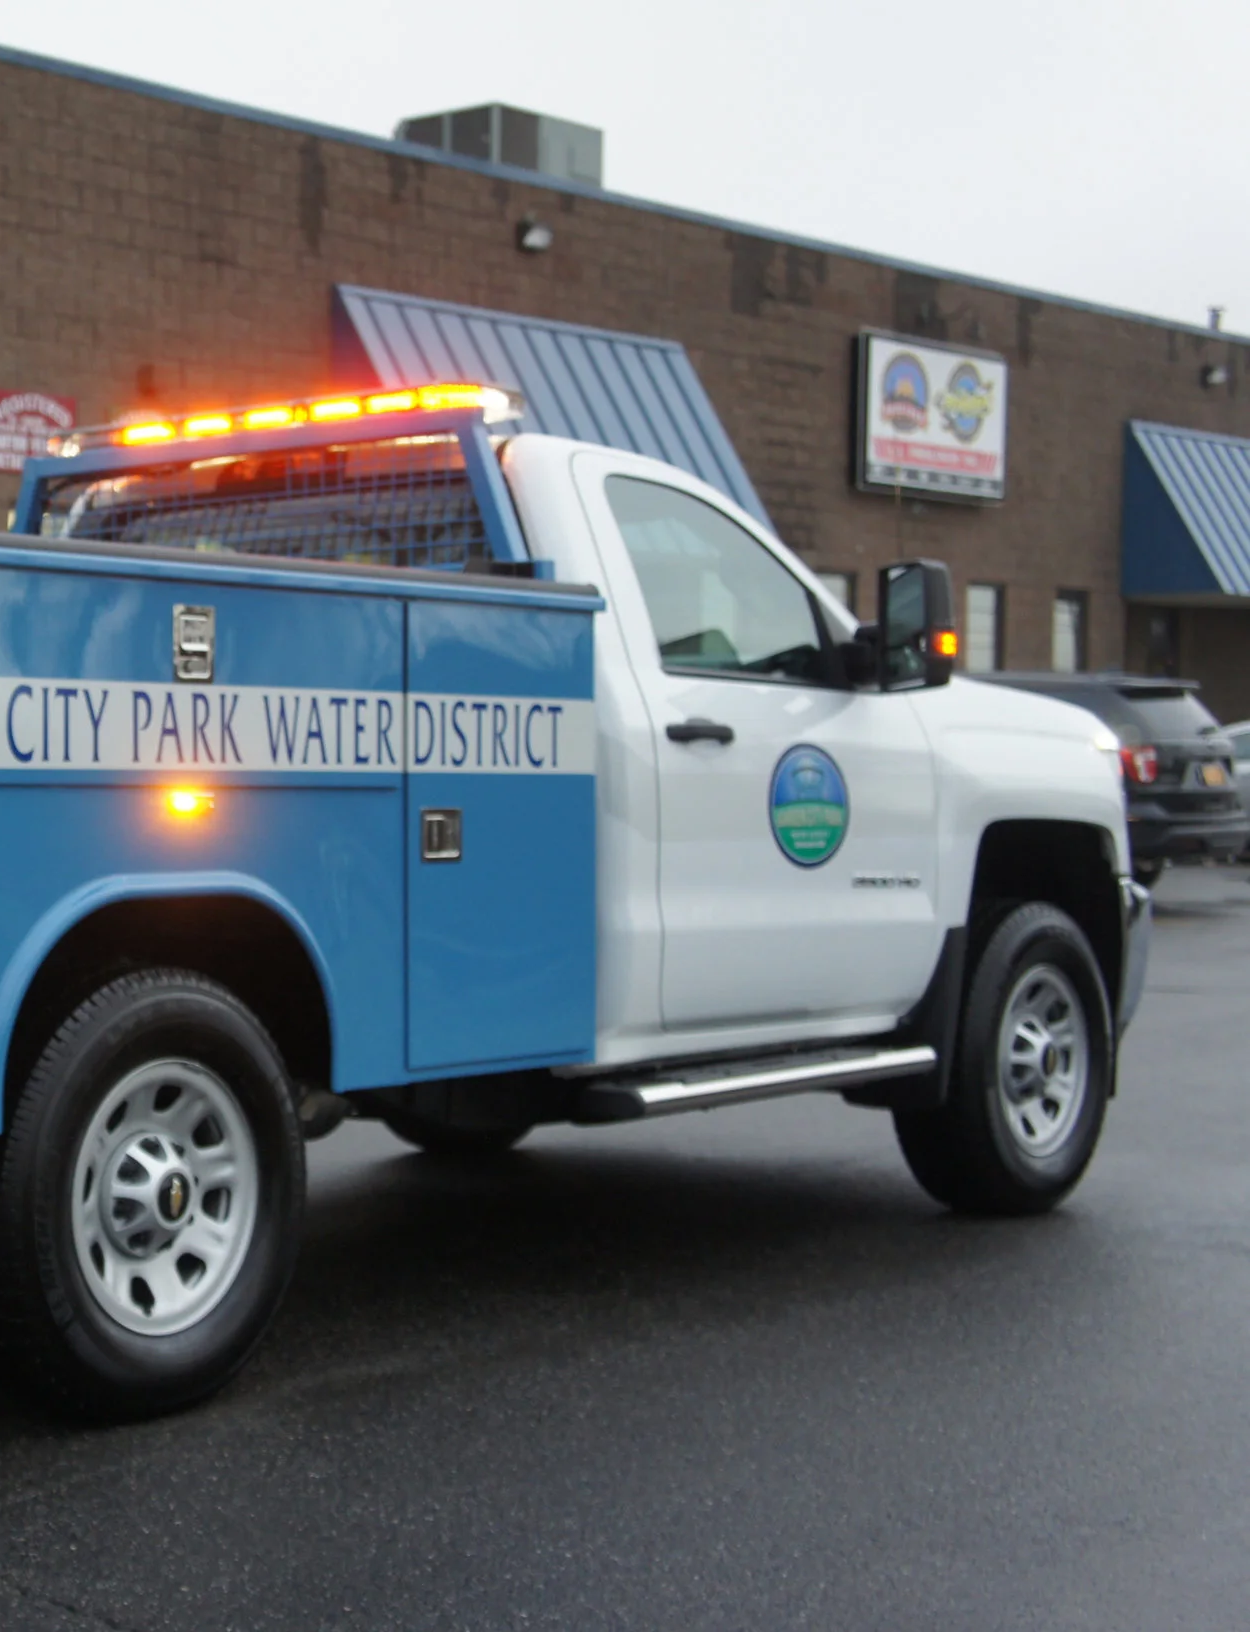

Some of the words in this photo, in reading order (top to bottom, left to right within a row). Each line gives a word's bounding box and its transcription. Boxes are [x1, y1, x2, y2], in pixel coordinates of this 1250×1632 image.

[6, 684, 109, 764] CITY
[132, 690, 243, 763] PARK
[263, 695, 397, 766] WATER
[413, 700, 564, 769] DISTRICT
